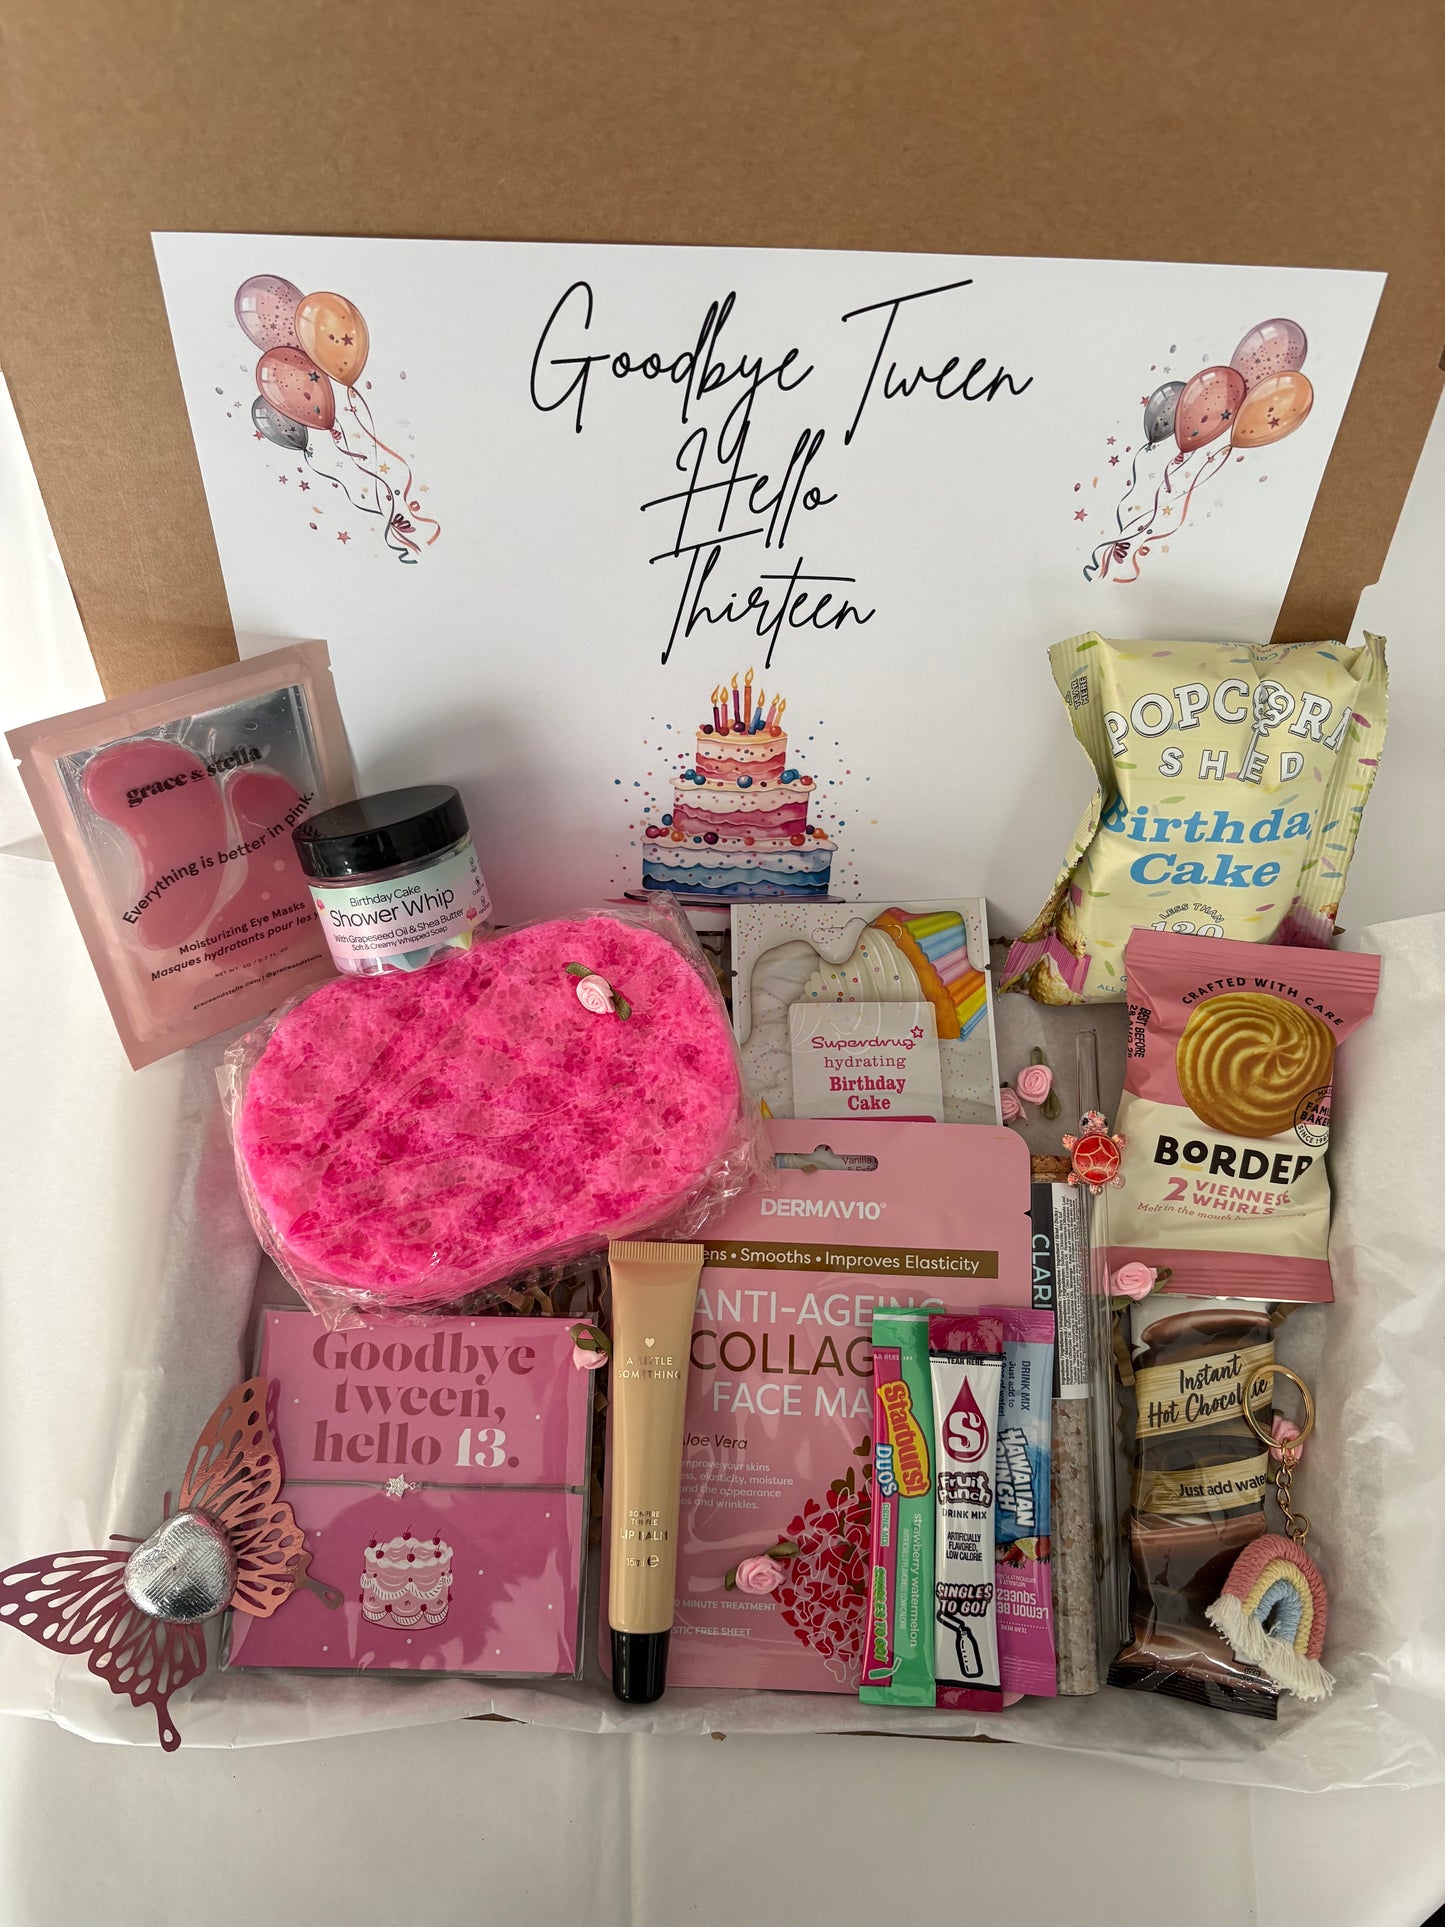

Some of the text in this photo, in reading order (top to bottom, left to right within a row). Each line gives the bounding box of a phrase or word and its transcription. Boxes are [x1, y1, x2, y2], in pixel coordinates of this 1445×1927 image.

[530, 280, 1033, 464] Goodbye Tween
[640, 419, 838, 558] Hello
[649, 528, 875, 669] Thirteen
[1070, 679, 1082, 710] TEAR
[1078, 675, 1090, 706] HERE
[126, 744, 263, 808] grace & stella
[1159, 747, 1304, 784] SHED
[1101, 788, 1318, 844] Birthda
[122, 791, 315, 925] Everything is better in pink.
[1129, 853, 1281, 888] Cake
[329, 906, 400, 928] Shower
[401, 887, 455, 918] Whip
[349, 884, 422, 908] Birthday Cake
[333, 933, 349, 944] With
[348, 930, 395, 944] Grapeseed
[395, 926, 408, 937] Oil
[408, 924, 418, 935] &
[417, 919, 441, 932] Shea
[440, 907, 465, 924] Butter
[1159, 902, 1225, 923] LESS THAN
[179, 922, 249, 956] Moisturizing
[250, 913, 271, 934] Eye
[272, 901, 306, 920] Masks
[351, 942, 364, 951] Soft
[370, 939, 398, 951] Creamy
[398, 931, 431, 947] Whipped
[430, 925, 449, 938] Soap
[151, 954, 202, 982] Masques
[204, 929, 266, 965] hydratants
[267, 922, 293, 940] pour
[295, 913, 312, 928] les
[193, 977, 261, 1010] graceandstella.com
[265, 953, 323, 978] @graceandstella
[1096, 983, 1116, 993] ALL
[1181, 977, 1344, 1027] CRAFTED WITH CARE
[811, 1036, 916, 1050] Superdrug
[1134, 1007, 1151, 1059] BEST BEFORE
[823, 1055, 907, 1071] hydrating
[829, 1075, 906, 1094] Birthday
[847, 1095, 891, 1111] Cake
[1300, 1110, 1330, 1126] BAKE
[1297, 1123, 1315, 1144] SINCE
[842, 1155, 872, 1165] Vanilla
[1162, 1176, 1189, 1202] 2
[1137, 1202, 1163, 1213] Melt
[1164, 1204, 1175, 1212] in
[1177, 1206, 1195, 1216] the
[1197, 1211, 1233, 1221] mouth
[1192, 1193, 1275, 1215] WHIRLS
[740, 1247, 811, 1265] Smooths
[825, 1251, 900, 1270] Improves
[905, 1254, 980, 1275] Elasticity
[1031, 1233, 1052, 1309] CLARI
[312, 1330, 537, 1385] Goodbye
[626, 1356, 634, 1365] A
[689, 1330, 874, 1377] COLLAG
[946, 1358, 984, 1367] TEAR HERE
[1008, 1361, 1016, 1408] Just add to
[1020, 1360, 1031, 1411] DRINK MIX
[1179, 1353, 1243, 1394] Instant
[335, 1375, 506, 1425] tween,
[713, 1381, 874, 1418] FACE MA
[1148, 1378, 1269, 1428] Hot Chocolte
[311, 1419, 520, 1469] hello 13.
[713, 1434, 748, 1450] Vera
[884, 1384, 929, 1493] Starburst
[681, 1460, 770, 1472] mprove your skins
[700, 1472, 747, 1485] elasticity,
[749, 1476, 794, 1486] moisture
[876, 1442, 899, 1498] DUOS
[998, 1428, 1036, 1528] HAWAIIAN
[700, 1484, 717, 1494] the
[720, 1488, 782, 1498] appearance
[938, 1484, 993, 1505] Punch
[939, 1474, 987, 1490] Fruit
[1178, 1473, 1268, 1498] Just add wate
[694, 1498, 714, 1507] and
[716, 1499, 760, 1510] wrinkles.
[942, 1510, 987, 1519] DRINK MIX
[620, 1529, 668, 1541] LIP BALM
[881, 1503, 892, 1547] DRINK MIX
[947, 1531, 981, 1543] ARTIFICIALLY
[946, 1551, 983, 1562] LOW CALORIE
[910, 1512, 922, 1648] strawberry watermelon
[937, 1584, 993, 1601] SINGLES
[682, 1600, 719, 1609] MINUTE
[719, 1601, 777, 1611] TREATMENT
[940, 1600, 958, 1614] TO
[960, 1600, 988, 1615] GO!
[997, 1589, 1037, 1605] SQUEEZ
[671, 1626, 752, 1637] STIC FREE SHEET
[874, 1619, 887, 1637] TO
